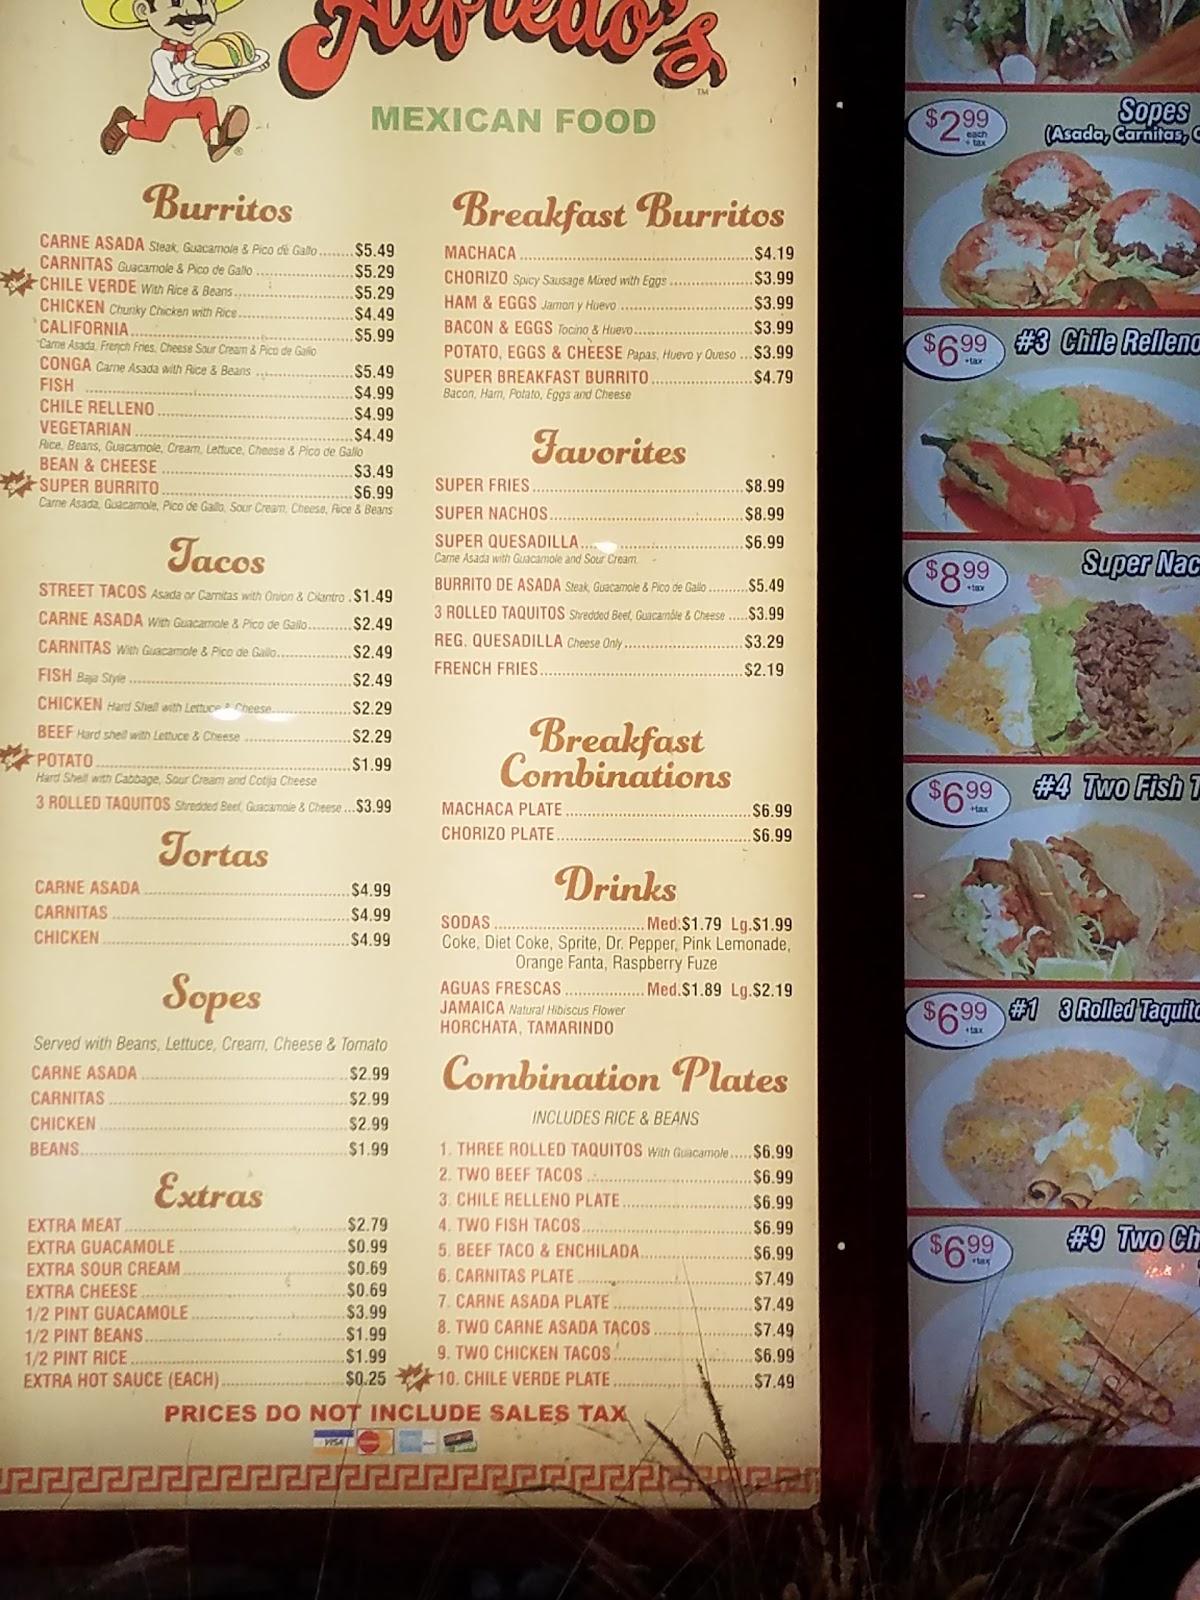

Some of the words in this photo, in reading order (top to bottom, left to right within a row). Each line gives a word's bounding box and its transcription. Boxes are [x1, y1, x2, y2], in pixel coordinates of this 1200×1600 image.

[370, 105, 541, 133] MEXICAN
[556, 108, 657, 135] FOOD
[1119, 96, 1190, 127] Sopes
[1045, 124, 1110, 146] (Asada,
[1113, 125, 1189, 146] Carnitas,
[141, 182, 293, 226] Burritos
[452, 190, 628, 235] Breakfast
[636, 191, 785, 229] Burritos
[40, 233, 89, 251] CARNE
[95, 235, 145, 253] ASADA
[183, 241, 240, 255] Guacamole
[252, 243, 274, 256] Pico
[277, 244, 290, 256] de
[293, 244, 317, 257] Gallo
[355, 242, 395, 258] $5.49
[445, 245, 516, 261] MACHACA
[754, 245, 794, 261] $4.19
[40, 277, 84, 292] CHILE
[88, 278, 137, 294] VERDE
[141, 283, 165, 296] With
[167, 284, 190, 296] Rice
[202, 285, 233, 297] Beans
[355, 285, 395, 301] $5.29
[444, 270, 508, 285] CHORIZO
[513, 274, 540, 288] Spicy
[543, 274, 585, 288] Sausage
[588, 274, 617, 287] Mixed
[620, 275, 640, 287] with
[643, 275, 667, 288] Eggs
[754, 270, 794, 286] $3.99
[1015, 328, 1051, 356] #3
[1060, 327, 1117, 356] Chile
[444, 369, 492, 384] SUPER
[498, 369, 580, 384] BREAKFAST
[585, 370, 649, 385] BURRITO
[754, 370, 793, 385] $4.79
[40, 378, 74, 393] FISH
[354, 385, 394, 401] $4.99
[531, 428, 687, 465] Favorites
[40, 479, 89, 493] SUPER
[95, 480, 159, 495] BURRITO
[354, 485, 394, 500] $6.99
[435, 477, 484, 493] SUPER
[489, 478, 530, 492] FRIES
[745, 478, 785, 493] $8.99
[167, 536, 266, 575] Tacos
[1082, 549, 1151, 580] Super
[435, 633, 468, 649] REG.
[472, 633, 563, 650] QUESADILLA
[567, 637, 600, 649] Cheese
[603, 637, 623, 651] Only
[745, 634, 785, 649] $3.29
[38, 667, 71, 683] FISH
[77, 672, 99, 686] Baja
[102, 672, 126, 685] Style
[353, 673, 392, 689] $2.49
[529, 717, 705, 761] Breakfast
[37, 753, 93, 768] POTATO
[352, 757, 392, 773] $1.99
[499, 752, 732, 789] Combinations
[1033, 773, 1071, 800] #4
[1083, 773, 1130, 800] Two
[1134, 774, 1185, 800] Fish
[441, 802, 513, 817] MACHACA
[519, 802, 562, 817] PLATE
[752, 803, 793, 819] $6.99
[159, 830, 269, 868] Tortas
[35, 880, 84, 895] CARNE
[90, 881, 140, 896] ASADA
[351, 882, 391, 898] $4.99
[554, 865, 677, 902] Drinks
[34, 930, 99, 945] CHICKEN
[351, 932, 391, 947] $4.99
[515, 954, 563, 973] Orange
[567, 955, 608, 972] Fanta,
[612, 955, 683, 973] Raspberry
[687, 956, 718, 971] Fuze
[162, 972, 261, 1024] Sopes
[440, 1001, 505, 1016] JAMAICA
[509, 1004, 545, 1016] Natural
[547, 1004, 589, 1016] Hibiscus
[592, 1004, 626, 1016] Flower
[1009, 997, 1039, 1021] #1
[1059, 997, 1073, 1021] 3
[1076, 997, 1136, 1022] Rolled
[34, 1036, 81, 1051] Served
[85, 1037, 112, 1051] with
[116, 1037, 161, 1053] Beans,
[165, 1037, 217, 1053] Lettuce,
[222, 1037, 268, 1053] Cream,
[274, 1037, 322, 1052] Cheese
[327, 1038, 336, 1052] &
[341, 1038, 388, 1053] Tomato
[442, 1054, 660, 1093] Combination
[671, 1055, 789, 1094] Plates
[532, 1110, 601, 1126] INCLUDES
[604, 1110, 635, 1126] RICE
[640, 1111, 649, 1126] &
[654, 1111, 700, 1126] BEANS
[30, 1142, 79, 1157] BEANS
[349, 1142, 389, 1157] $1.99
[154, 1172, 265, 1209] Extras
[28, 1218, 76, 1234] EXTRA
[81, 1217, 122, 1232] MEAT
[348, 1217, 388, 1232] $2.79
[438, 1217, 452, 1233] 4.
[457, 1218, 490, 1233] TWO
[495, 1218, 529, 1233] FISH
[534, 1218, 580, 1233] TACOS
[753, 1220, 794, 1235] $6.99
[1067, 1224, 1105, 1253] #9
[1118, 1224, 1164, 1252] Two
[25, 1350, 48, 1366] 1/2
[53, 1350, 88, 1366] PINT
[93, 1350, 127, 1366] RICE
[346, 1349, 386, 1364] $1.99
[24, 1374, 72, 1389] EXTRA
[78, 1373, 108, 1388] HOT
[113, 1372, 163, 1388] SAUCE
[168, 1371, 219, 1389] (EACH)
[346, 1371, 386, 1387] $0.25
[438, 1371, 460, 1387] 10.
[465, 1371, 507, 1387] CHILE
[512, 1371, 561, 1387] VERDE
[566, 1371, 611, 1387] PLATE
[754, 1373, 794, 1389] $7.49
[164, 1404, 257, 1423] PRICES
[264, 1404, 301, 1423] DO
[310, 1404, 363, 1423] NOT
[370, 1404, 482, 1423] INCLUDE
[489, 1404, 570, 1423] SALES
[578, 1404, 627, 1423] TAX
[324, 1438, 344, 1447] VISA
